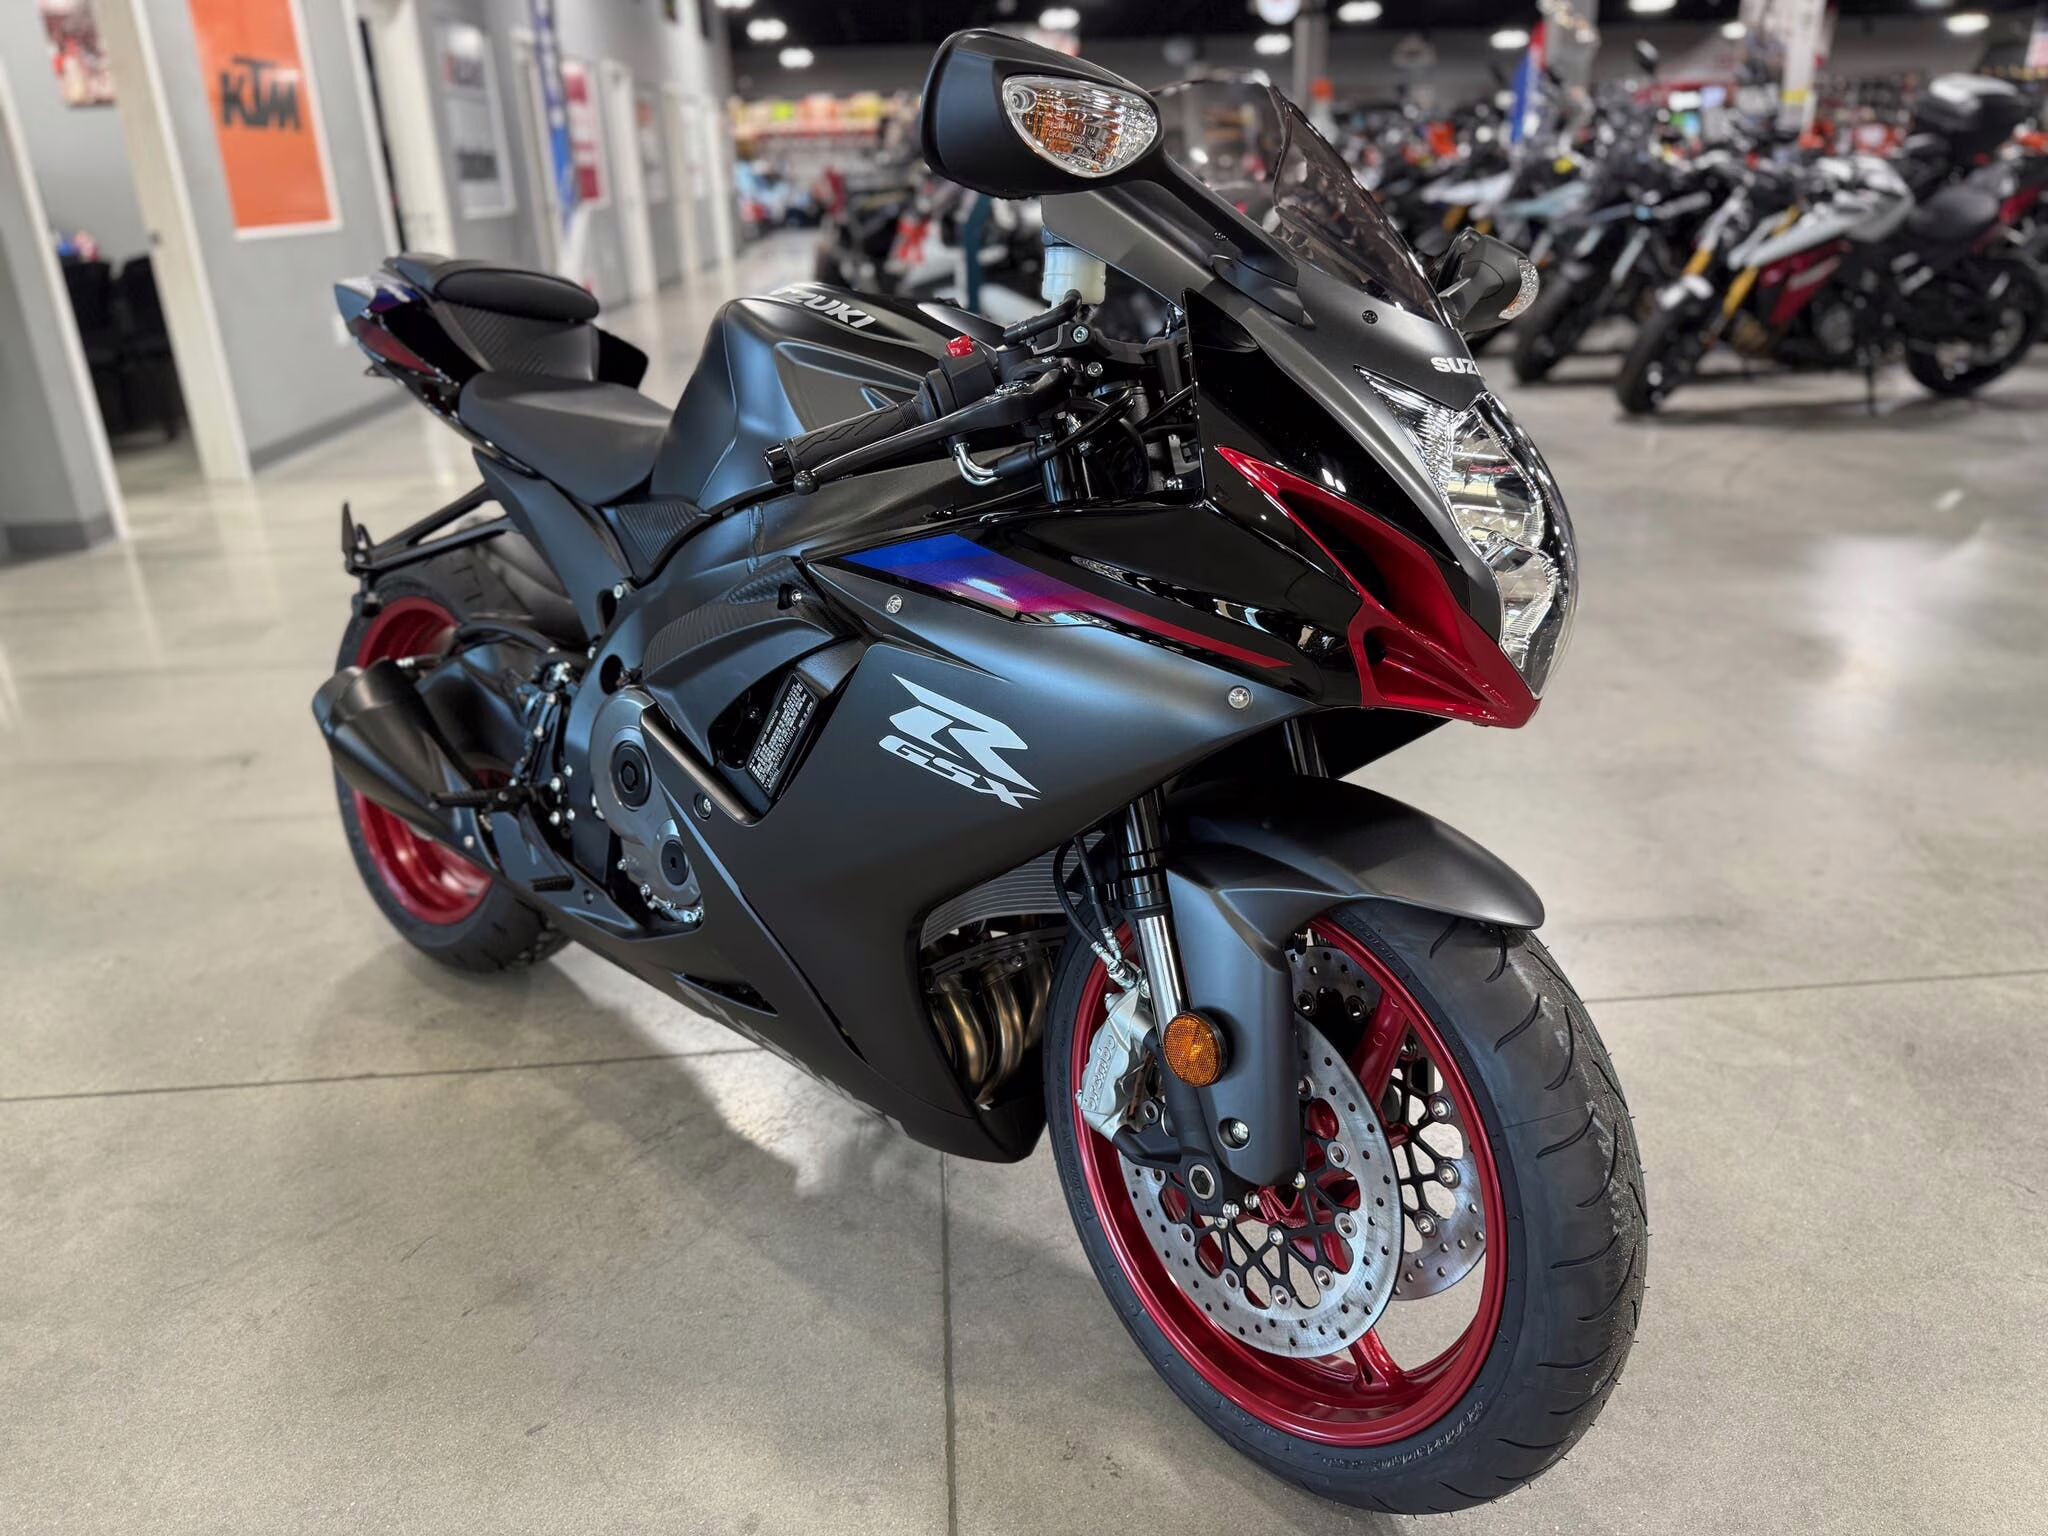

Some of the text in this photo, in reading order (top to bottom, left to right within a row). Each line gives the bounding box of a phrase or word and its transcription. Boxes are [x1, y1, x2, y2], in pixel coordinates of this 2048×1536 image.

[220, 55, 302, 132] KTM
[889, 673, 1042, 793] R
[878, 734, 1042, 810] GSX
